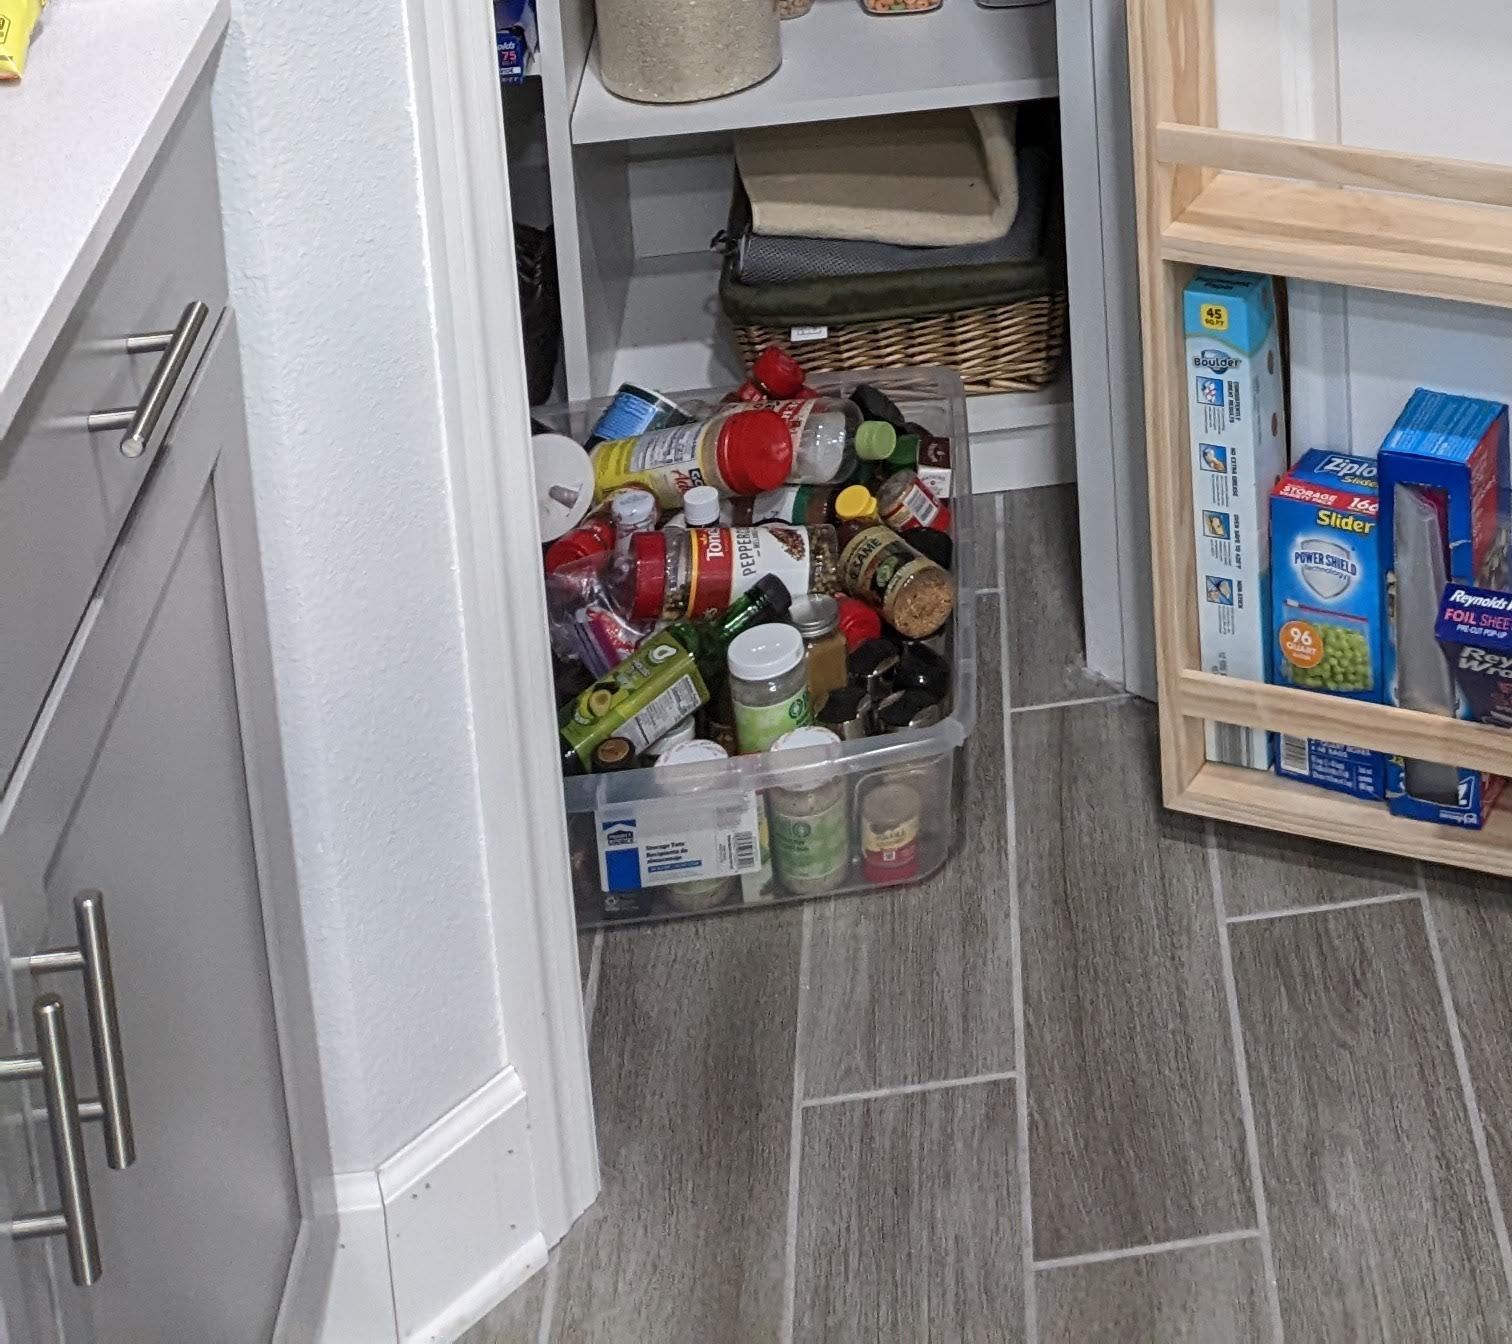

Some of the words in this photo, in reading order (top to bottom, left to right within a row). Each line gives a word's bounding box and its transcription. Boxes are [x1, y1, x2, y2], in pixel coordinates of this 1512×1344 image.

[502, 51, 517, 62] 75
[1206, 307, 1222, 319] 45
[1193, 356, 1239, 368] Boulder
[1341, 475, 1378, 488] Slide
[1281, 484, 1338, 502] STORAGE
[1317, 509, 1376, 534] Slider
[1294, 551, 1325, 566] POWER
[1324, 553, 1358, 577] SHIELD
[1449, 589, 1508, 611] Reynolds
[1444, 608, 1477, 625] FOIL
[1289, 626, 1313, 646] 96
[1456, 624, 1484, 636] PRE-CUT
[1483, 627, 1509, 639] POP-UP
[1286, 640, 1318, 656] QUART
